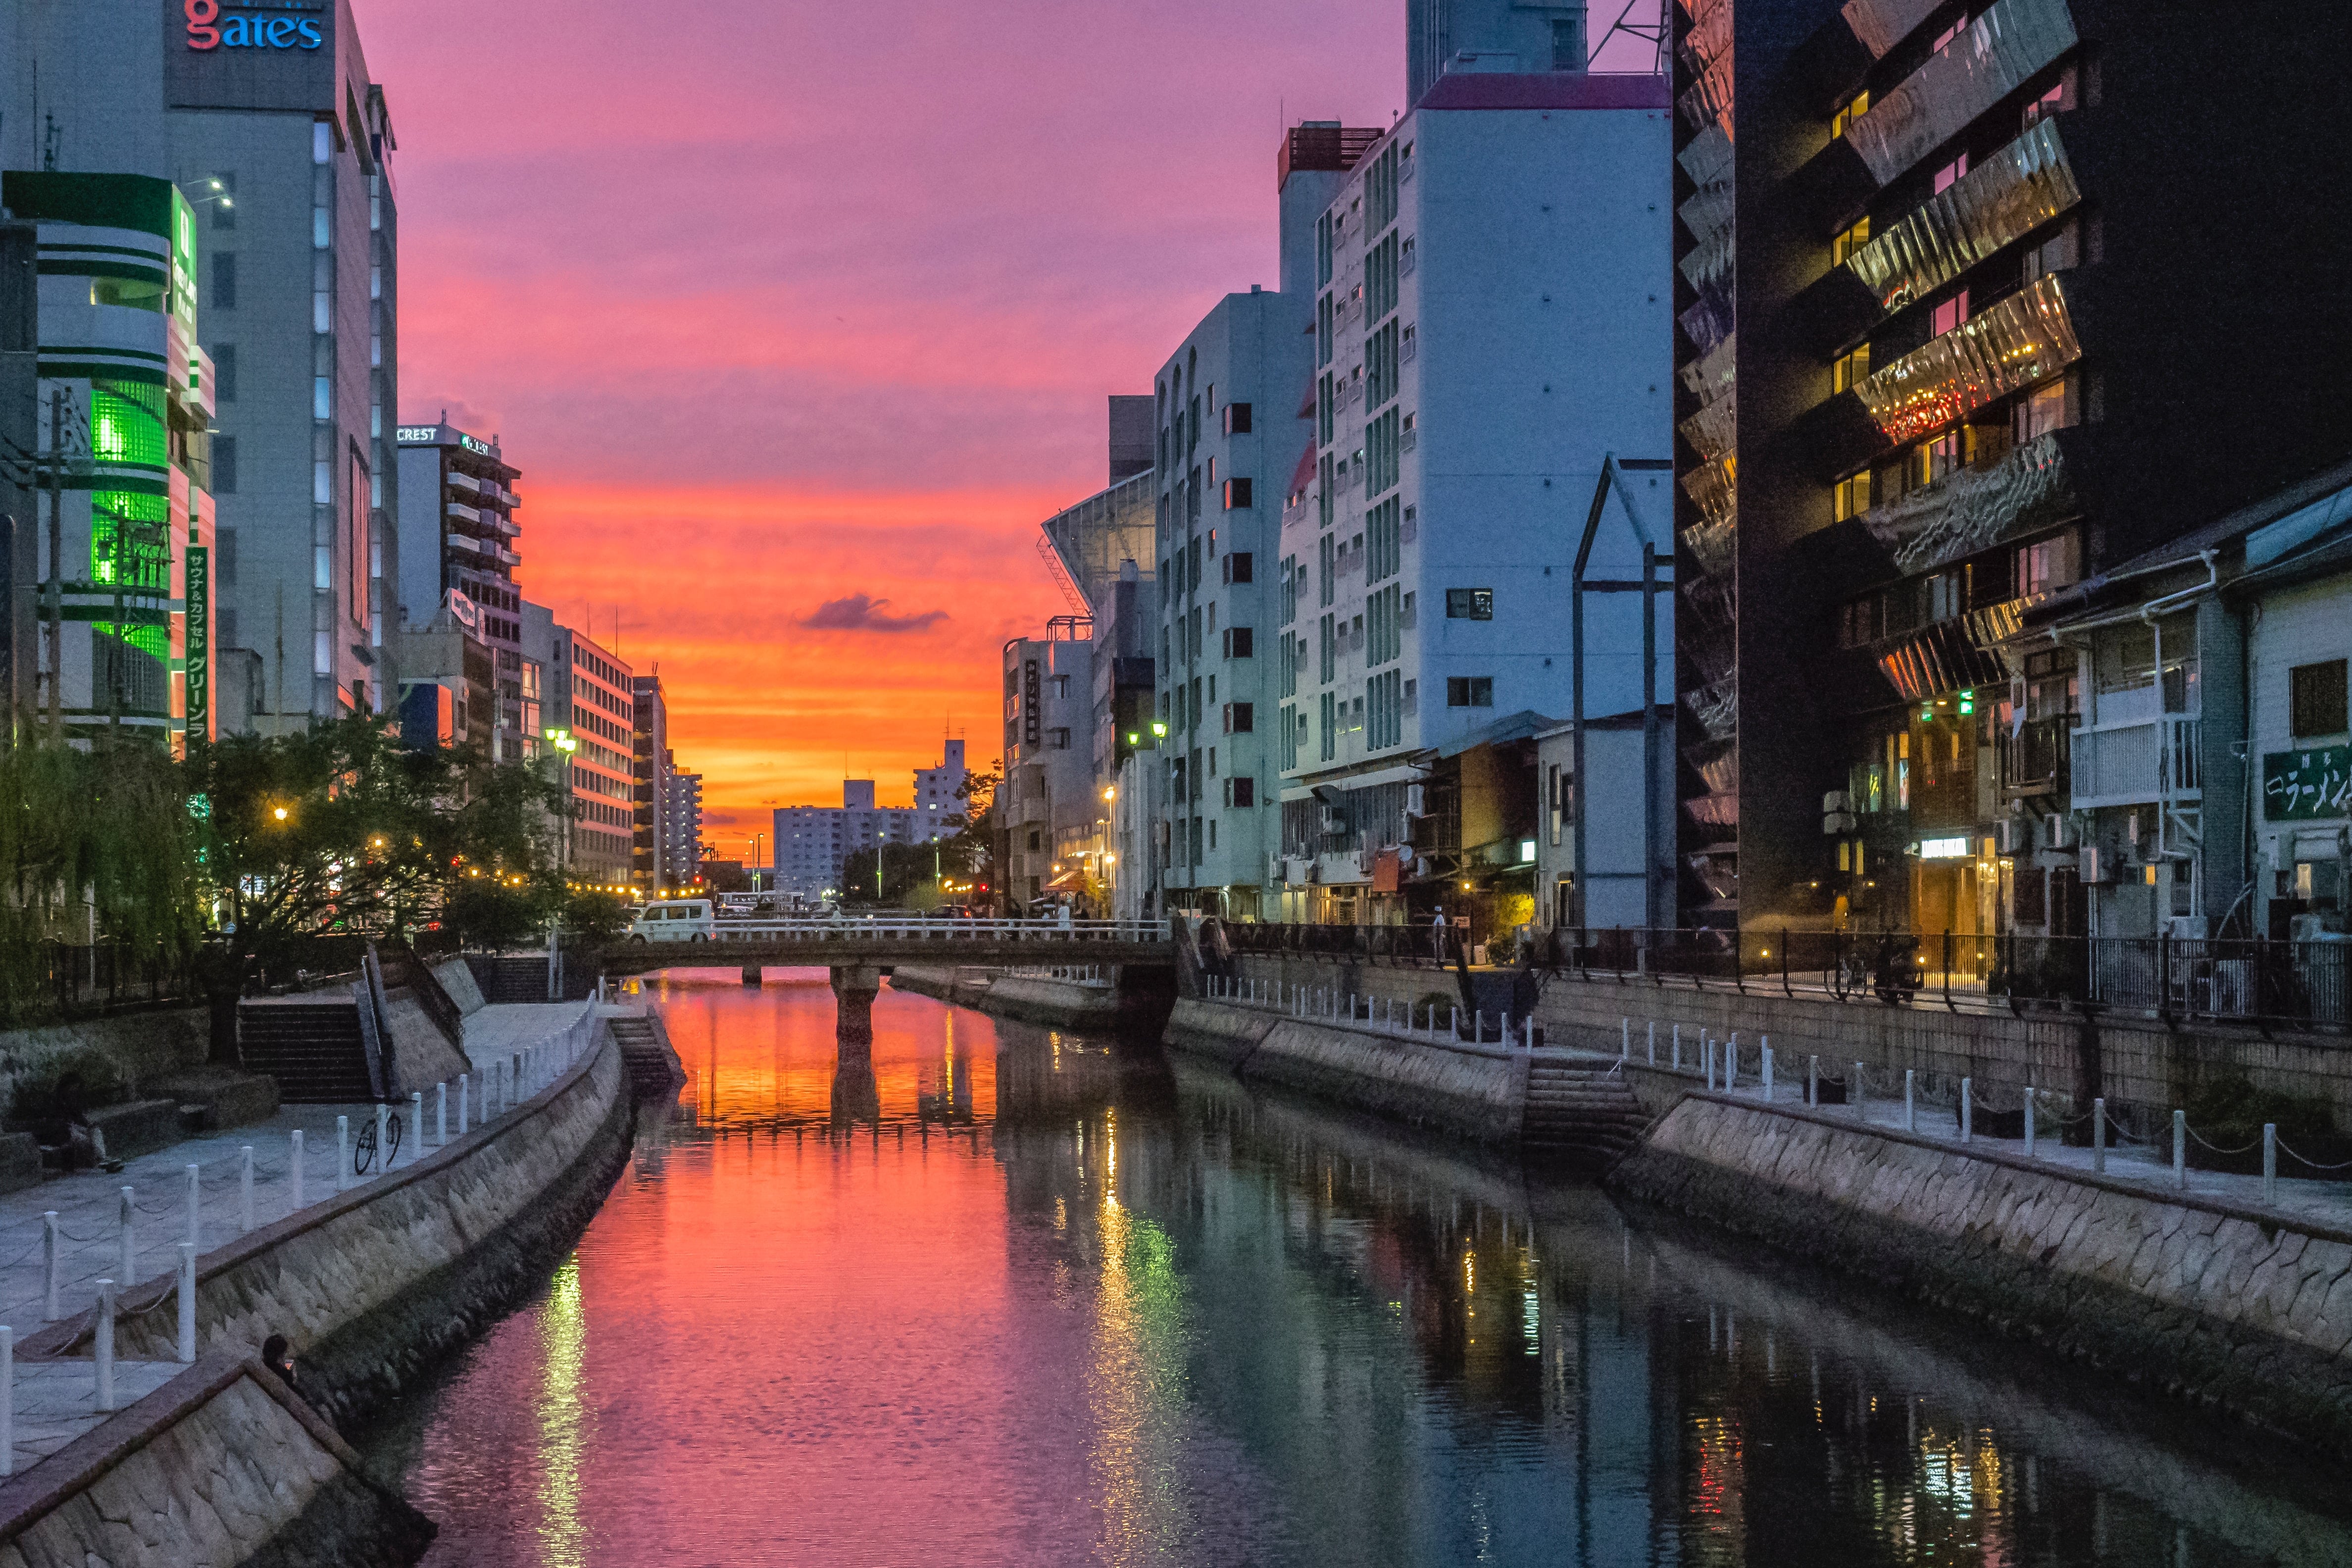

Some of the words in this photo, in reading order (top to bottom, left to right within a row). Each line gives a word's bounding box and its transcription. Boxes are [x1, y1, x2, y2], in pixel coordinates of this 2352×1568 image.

[184, 0, 322, 49] gate's
[397, 428, 437, 441] CREST
[189, 656, 206, 754] グリーンラ
[2286, 766, 2352, 812] ラーメン
